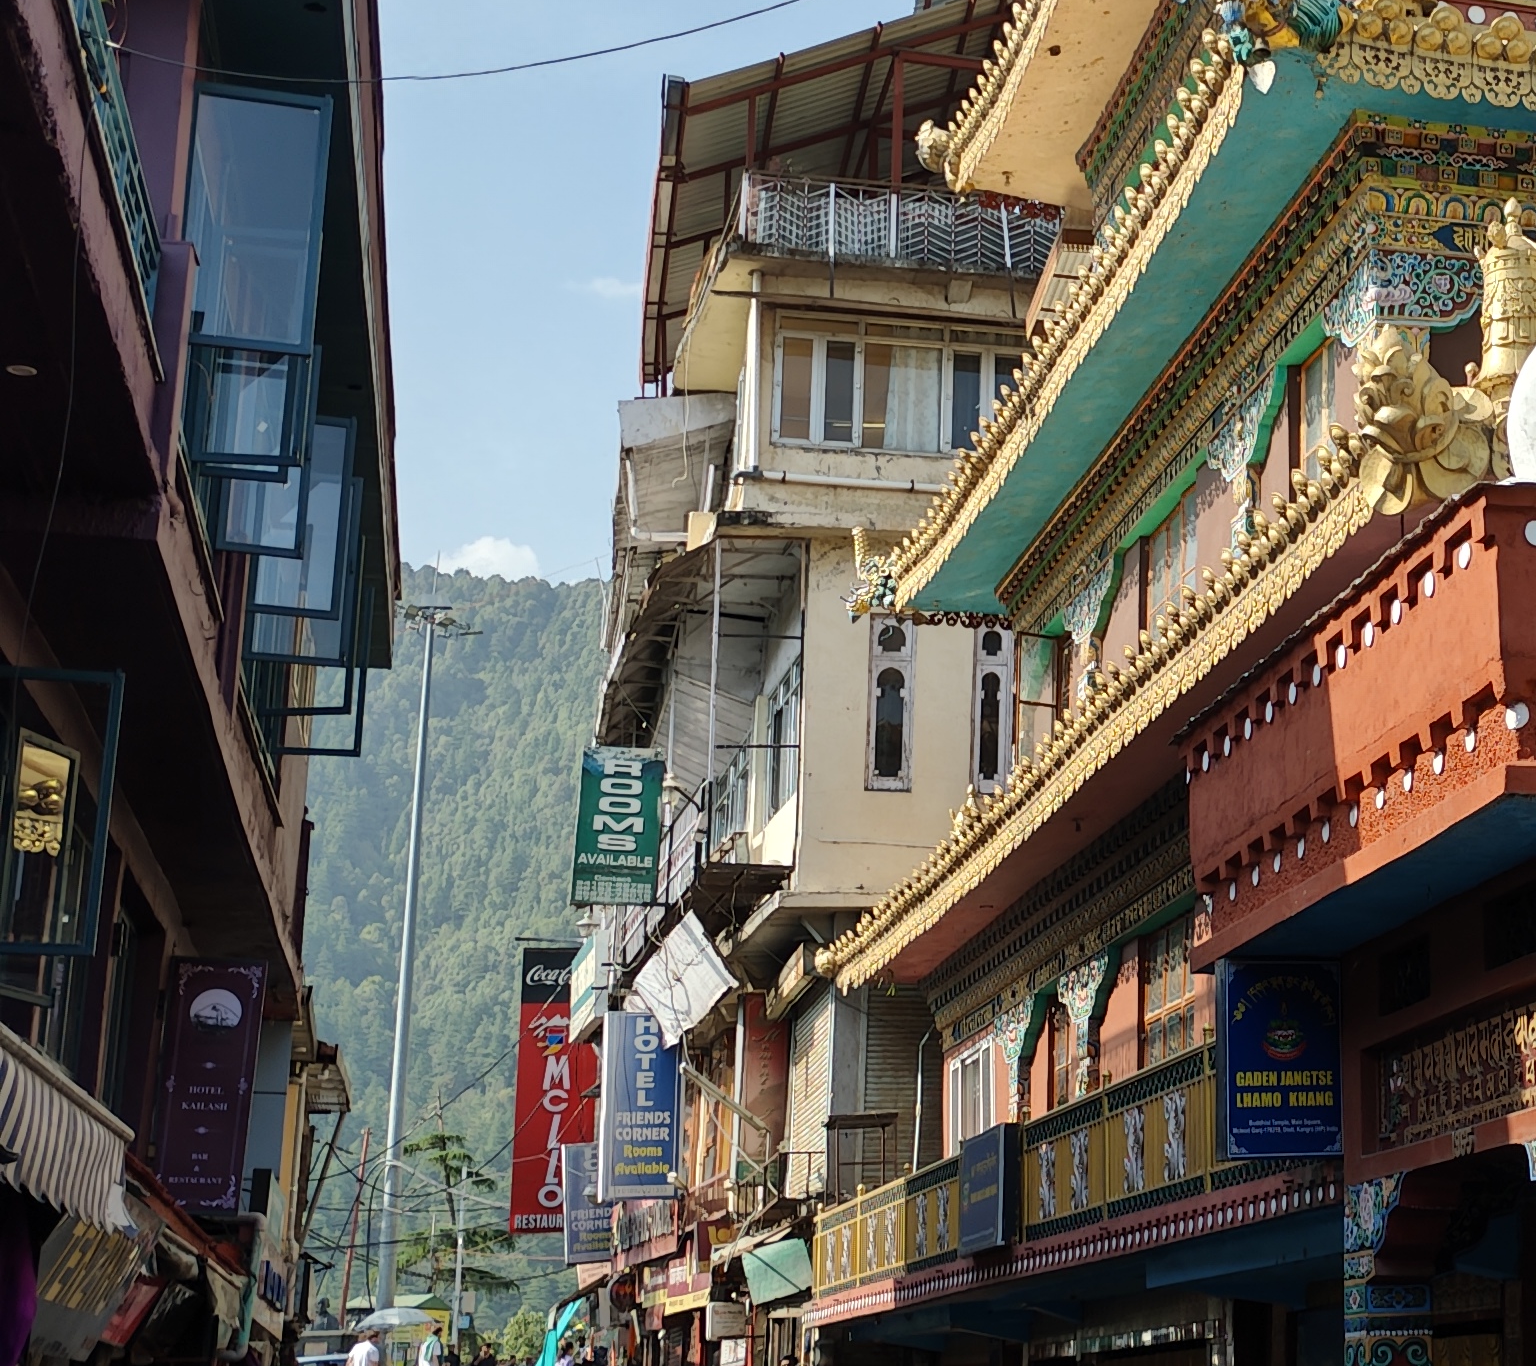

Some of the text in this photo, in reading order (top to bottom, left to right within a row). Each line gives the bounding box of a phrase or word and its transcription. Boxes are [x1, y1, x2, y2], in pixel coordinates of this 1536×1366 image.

[592, 759, 645, 852] ROOMS
[577, 852, 653, 868] AVAILABLE
[634, 1016, 660, 1107] HOTEL
[1235, 1070, 1333, 1087] GADEN JANGTSE
[189, 1086, 224, 1095] HOTEL
[181, 1101, 228, 1111] KAILASH
[1236, 1090, 1334, 1108] LHAMO KHANG
[615, 1111, 671, 1126] FRIENDS
[615, 1126, 670, 1141] CORNER
[191, 1152, 209, 1160] BAR
[623, 1144, 663, 1158] Rooms
[614, 1162, 670, 1176] Available
[168, 1176, 223, 1185] RESTAURANT
[570, 1207, 612, 1221] FRIEND
[514, 1214, 563, 1229] RESTAUR
[571, 1219, 611, 1232] CORNE
